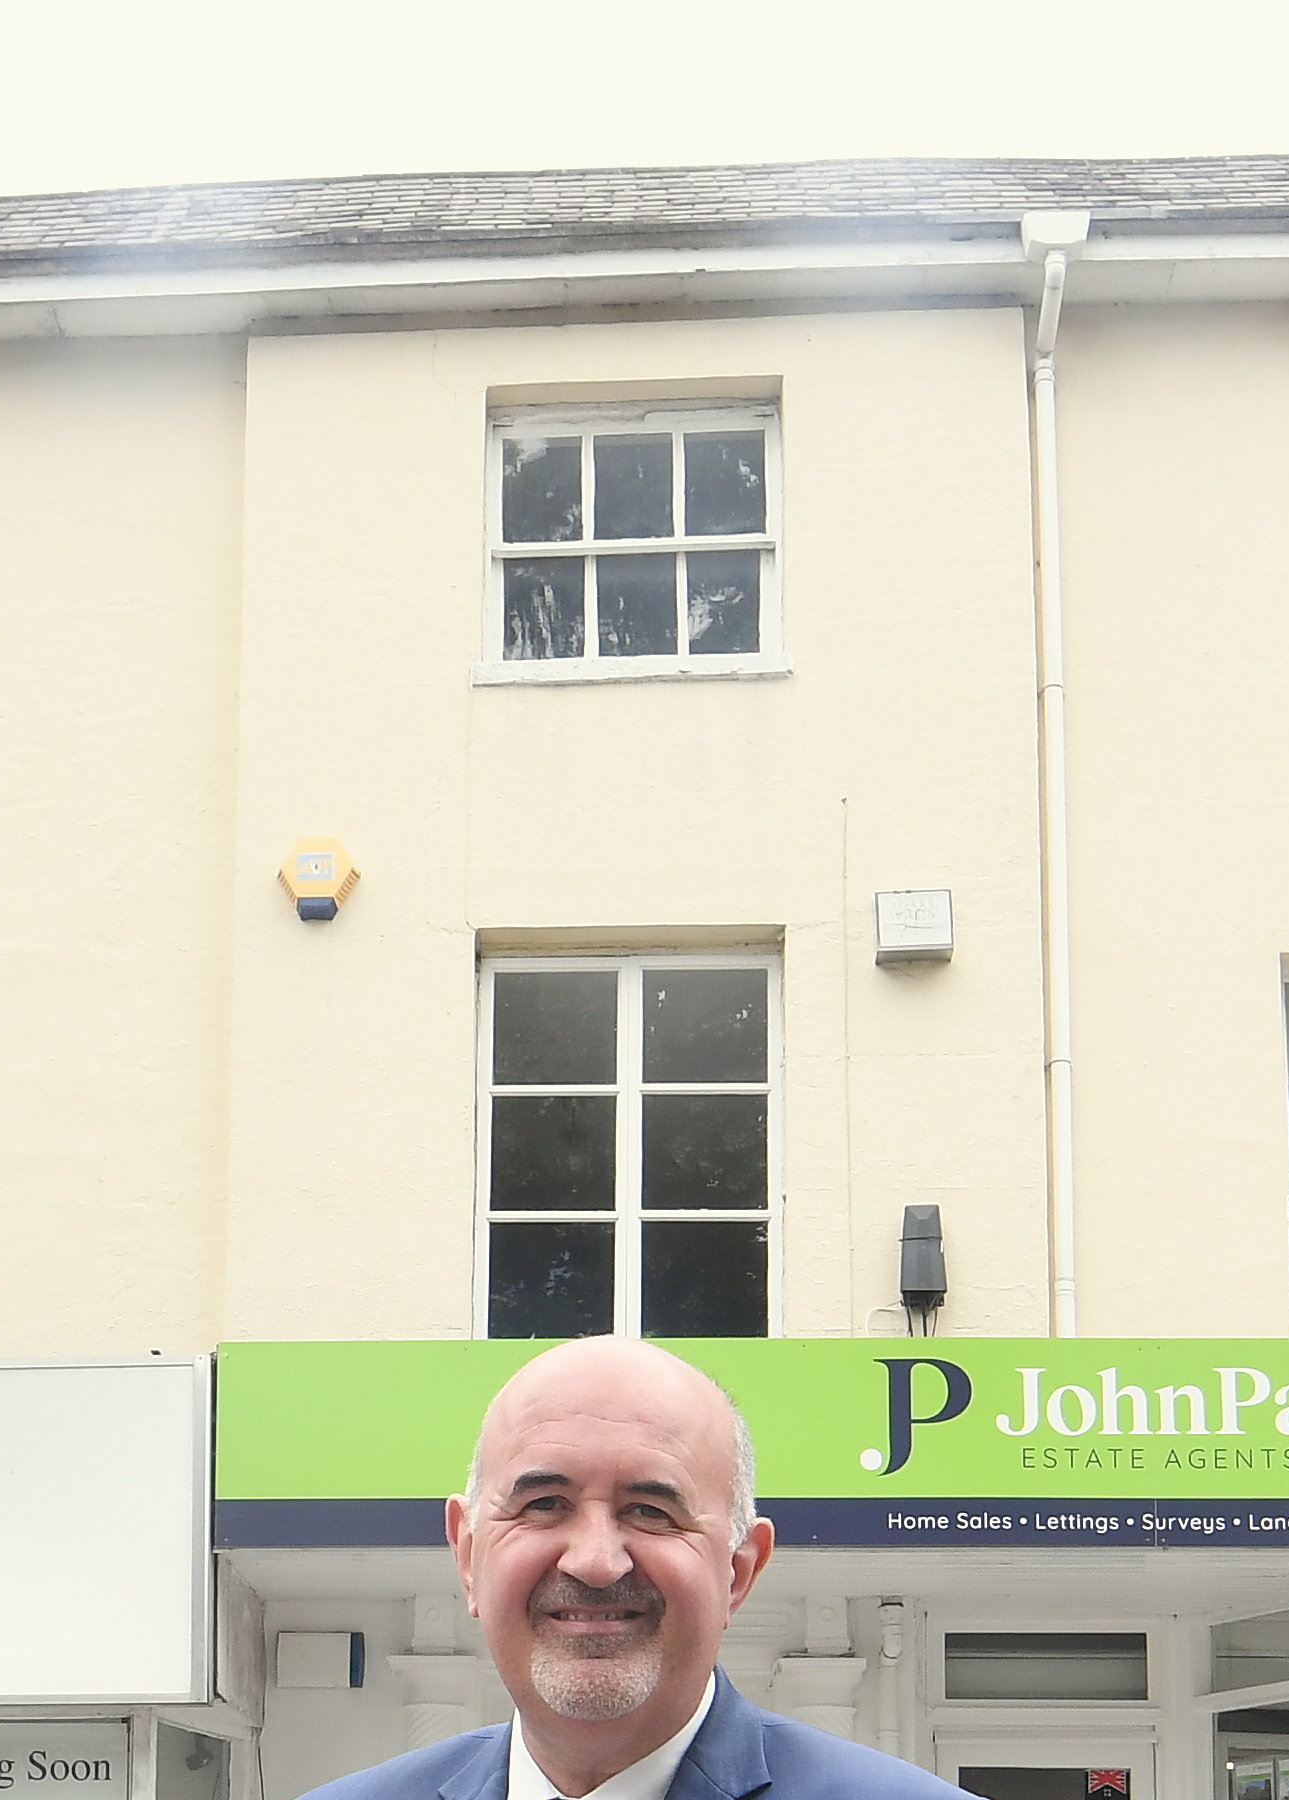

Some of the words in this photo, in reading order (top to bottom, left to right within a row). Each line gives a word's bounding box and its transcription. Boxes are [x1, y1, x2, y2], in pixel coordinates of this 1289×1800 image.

[1022, 1448, 1145, 1469] ESTATE
[887, 1512, 949, 1530] Home
[956, 1512, 1012, 1530] Sales
[1035, 1513, 1119, 1533] Lettings
[1141, 1513, 1226, 1534] Surveys
[27, 1750, 112, 1781] Soon
